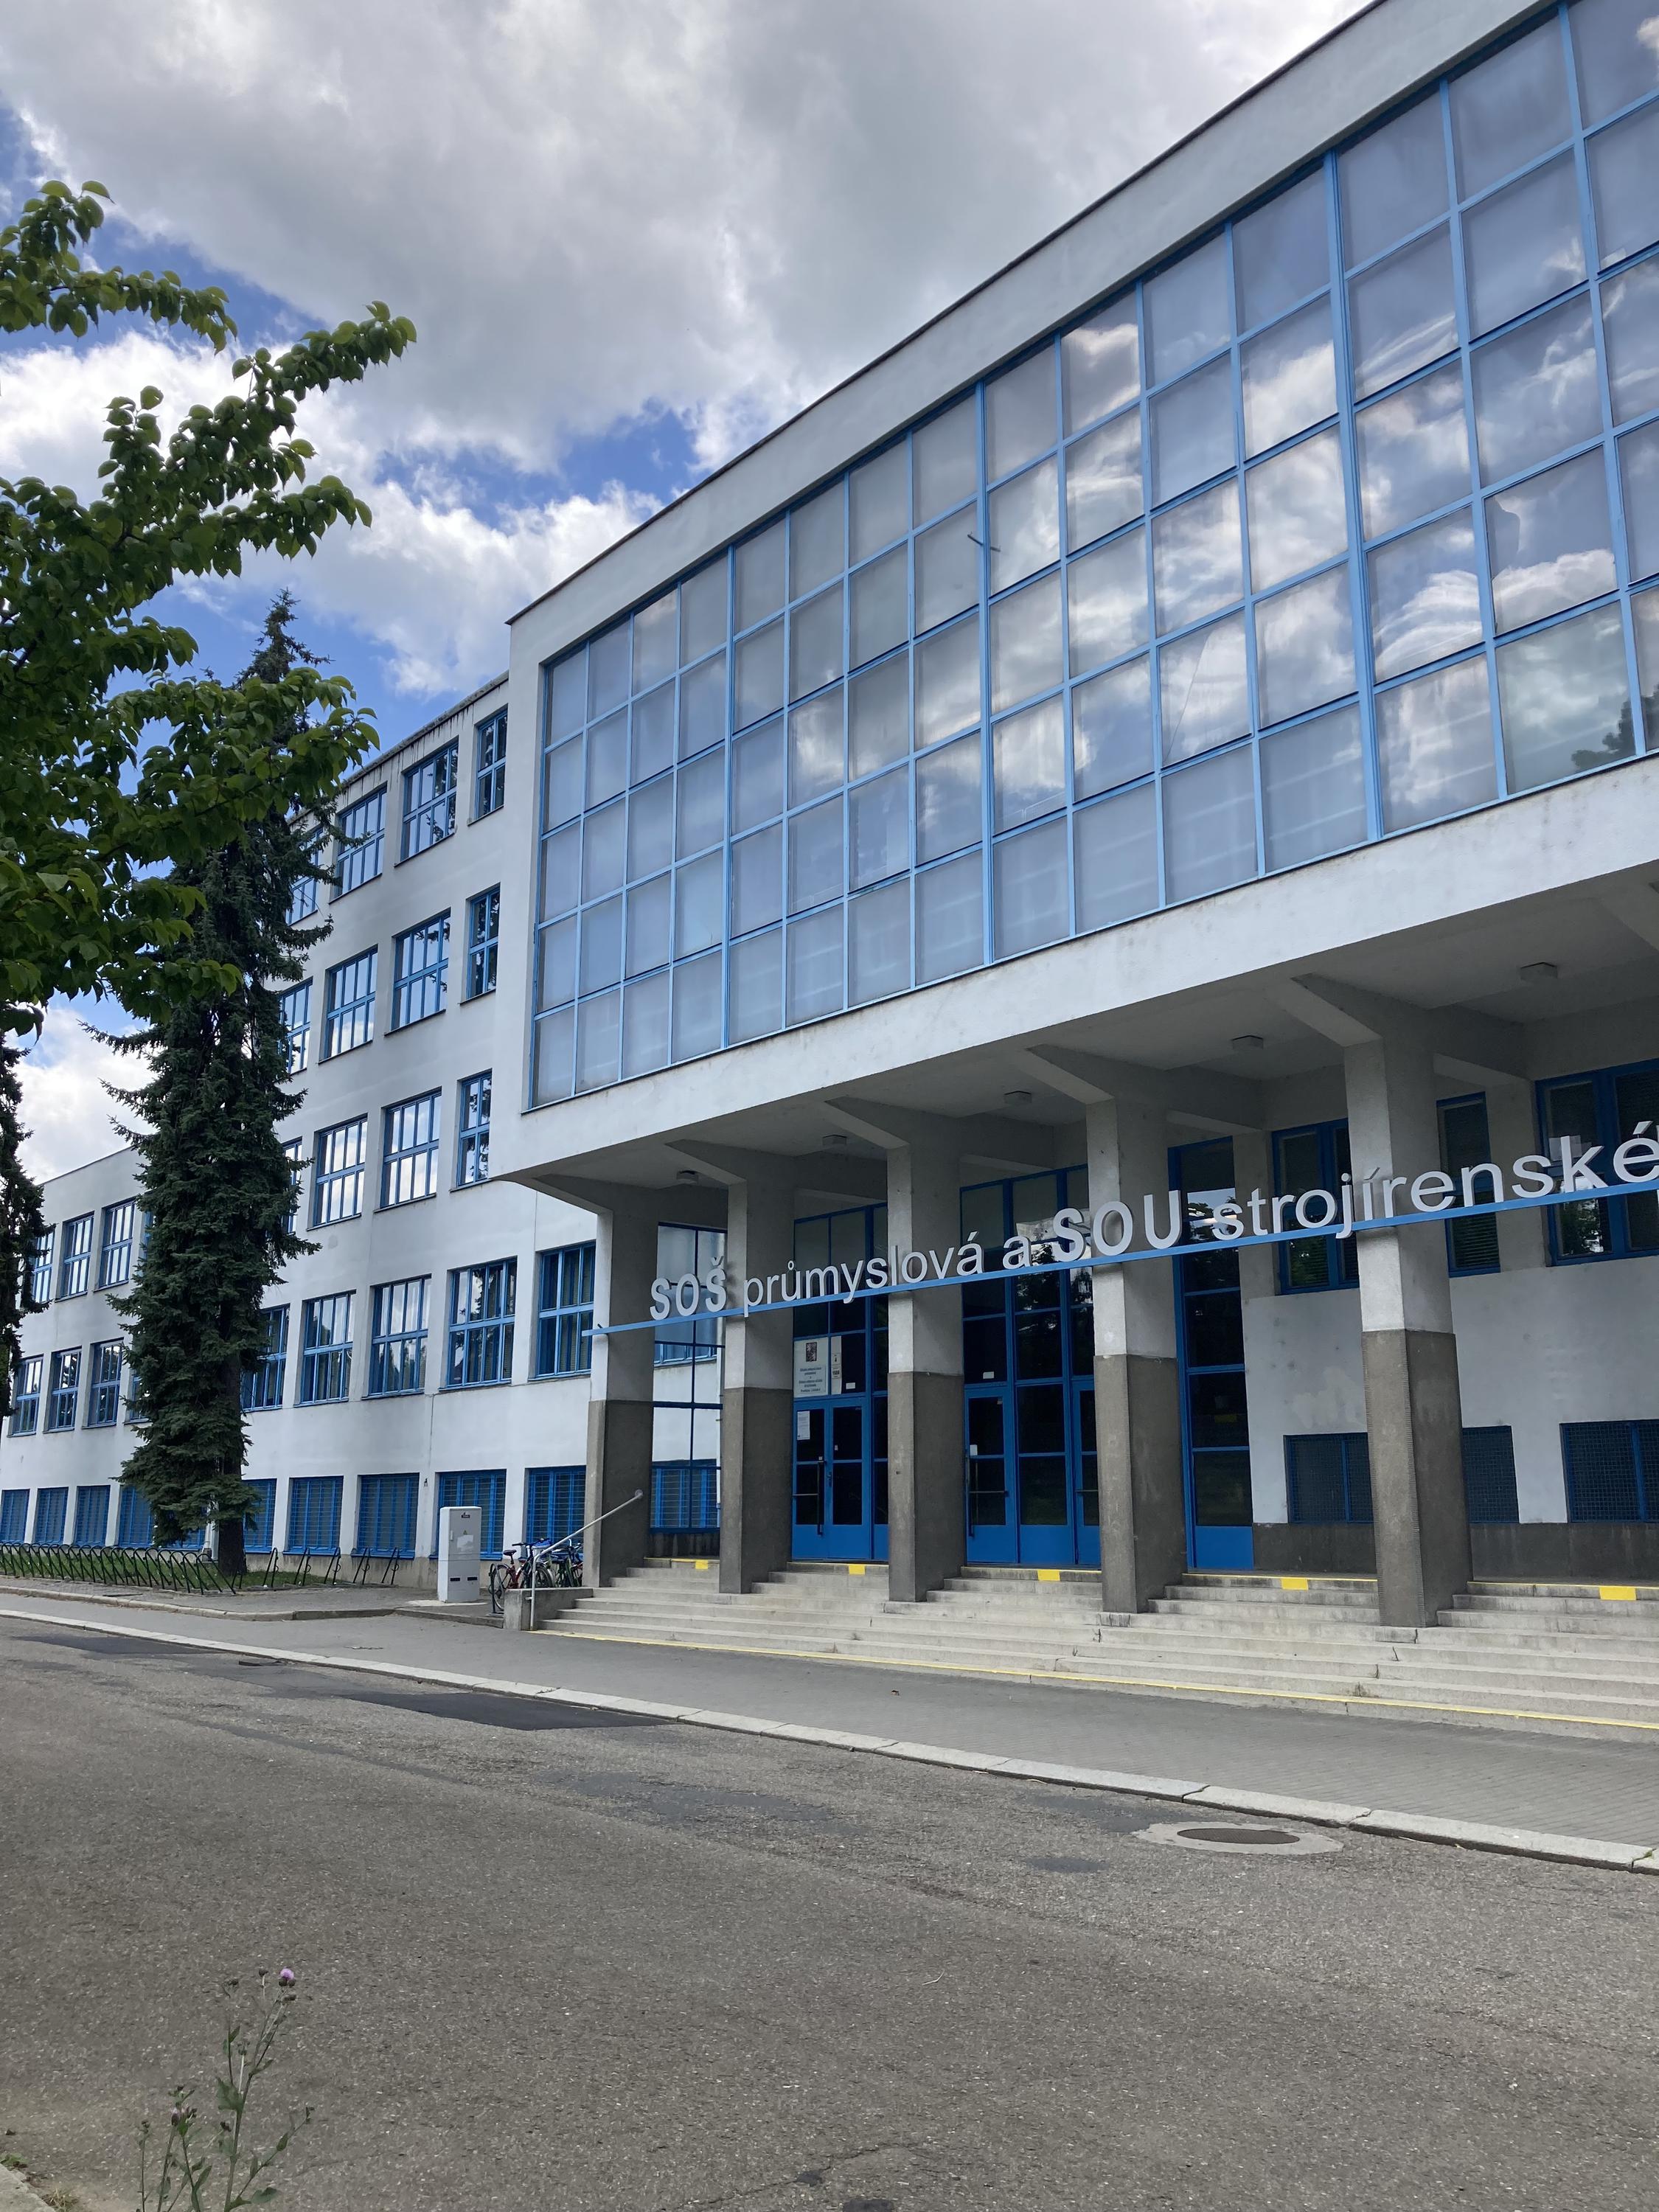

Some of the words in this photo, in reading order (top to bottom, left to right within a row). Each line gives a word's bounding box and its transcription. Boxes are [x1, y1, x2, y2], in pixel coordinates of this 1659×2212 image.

[650, 1256, 727, 1320] SOŠ
[743, 1231, 984, 1318] průmyslová
[1003, 1235, 1032, 1269] a
[1053, 1189, 1181, 1262] SOU
[1212, 1121, 1659, 1239] strojírenské
